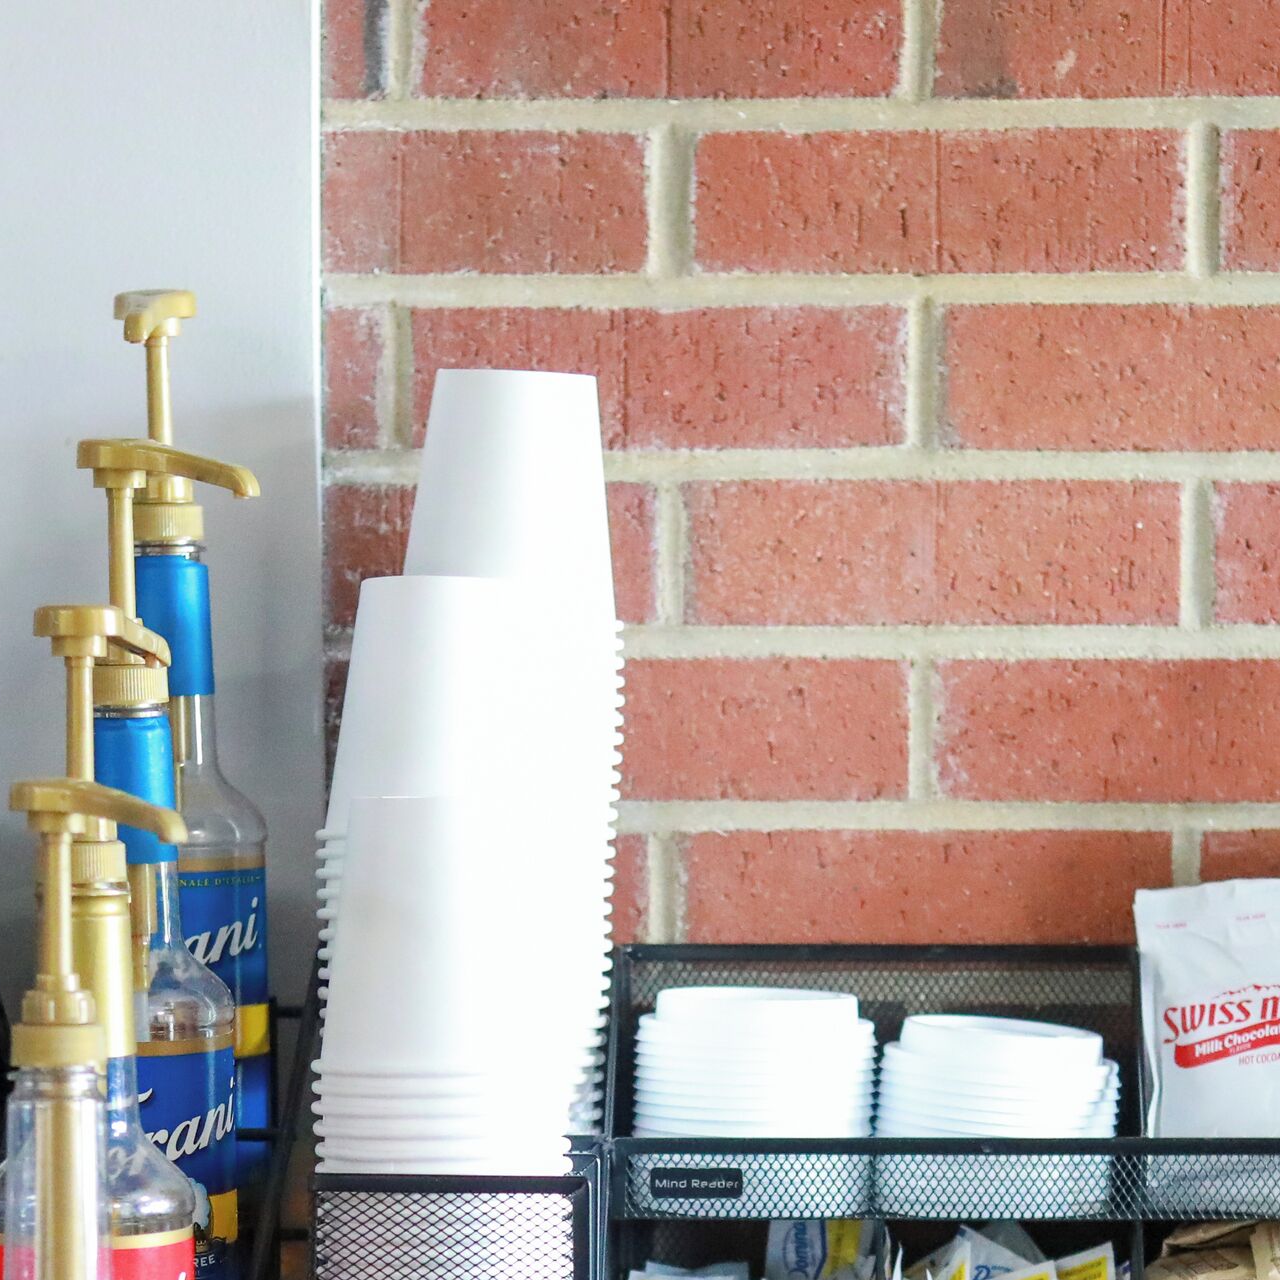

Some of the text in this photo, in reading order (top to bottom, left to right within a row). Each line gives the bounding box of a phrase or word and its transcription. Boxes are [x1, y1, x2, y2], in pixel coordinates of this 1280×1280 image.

[1194, 1040, 1222, 1058] Milk
[1239, 1055, 1254, 1066] HOT
[655, 1179, 739, 1190] Mind Reader
